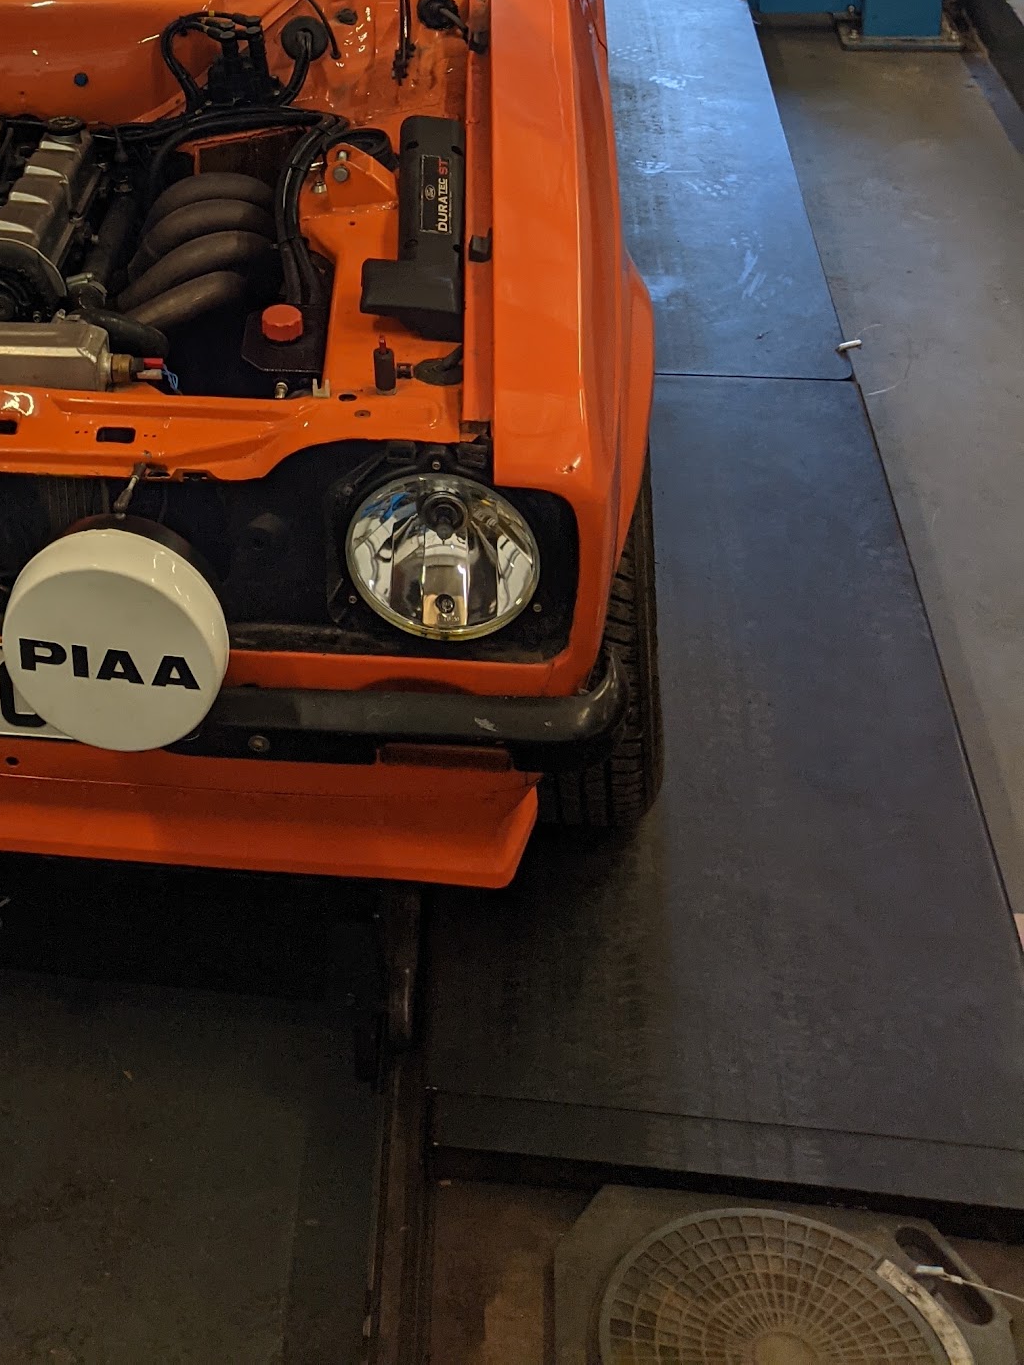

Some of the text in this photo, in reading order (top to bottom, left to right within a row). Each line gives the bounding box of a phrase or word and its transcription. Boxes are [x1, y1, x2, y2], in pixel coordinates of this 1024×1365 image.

[437, 158, 448, 232] DURATEC ST
[18, 637, 201, 690] PIAA
